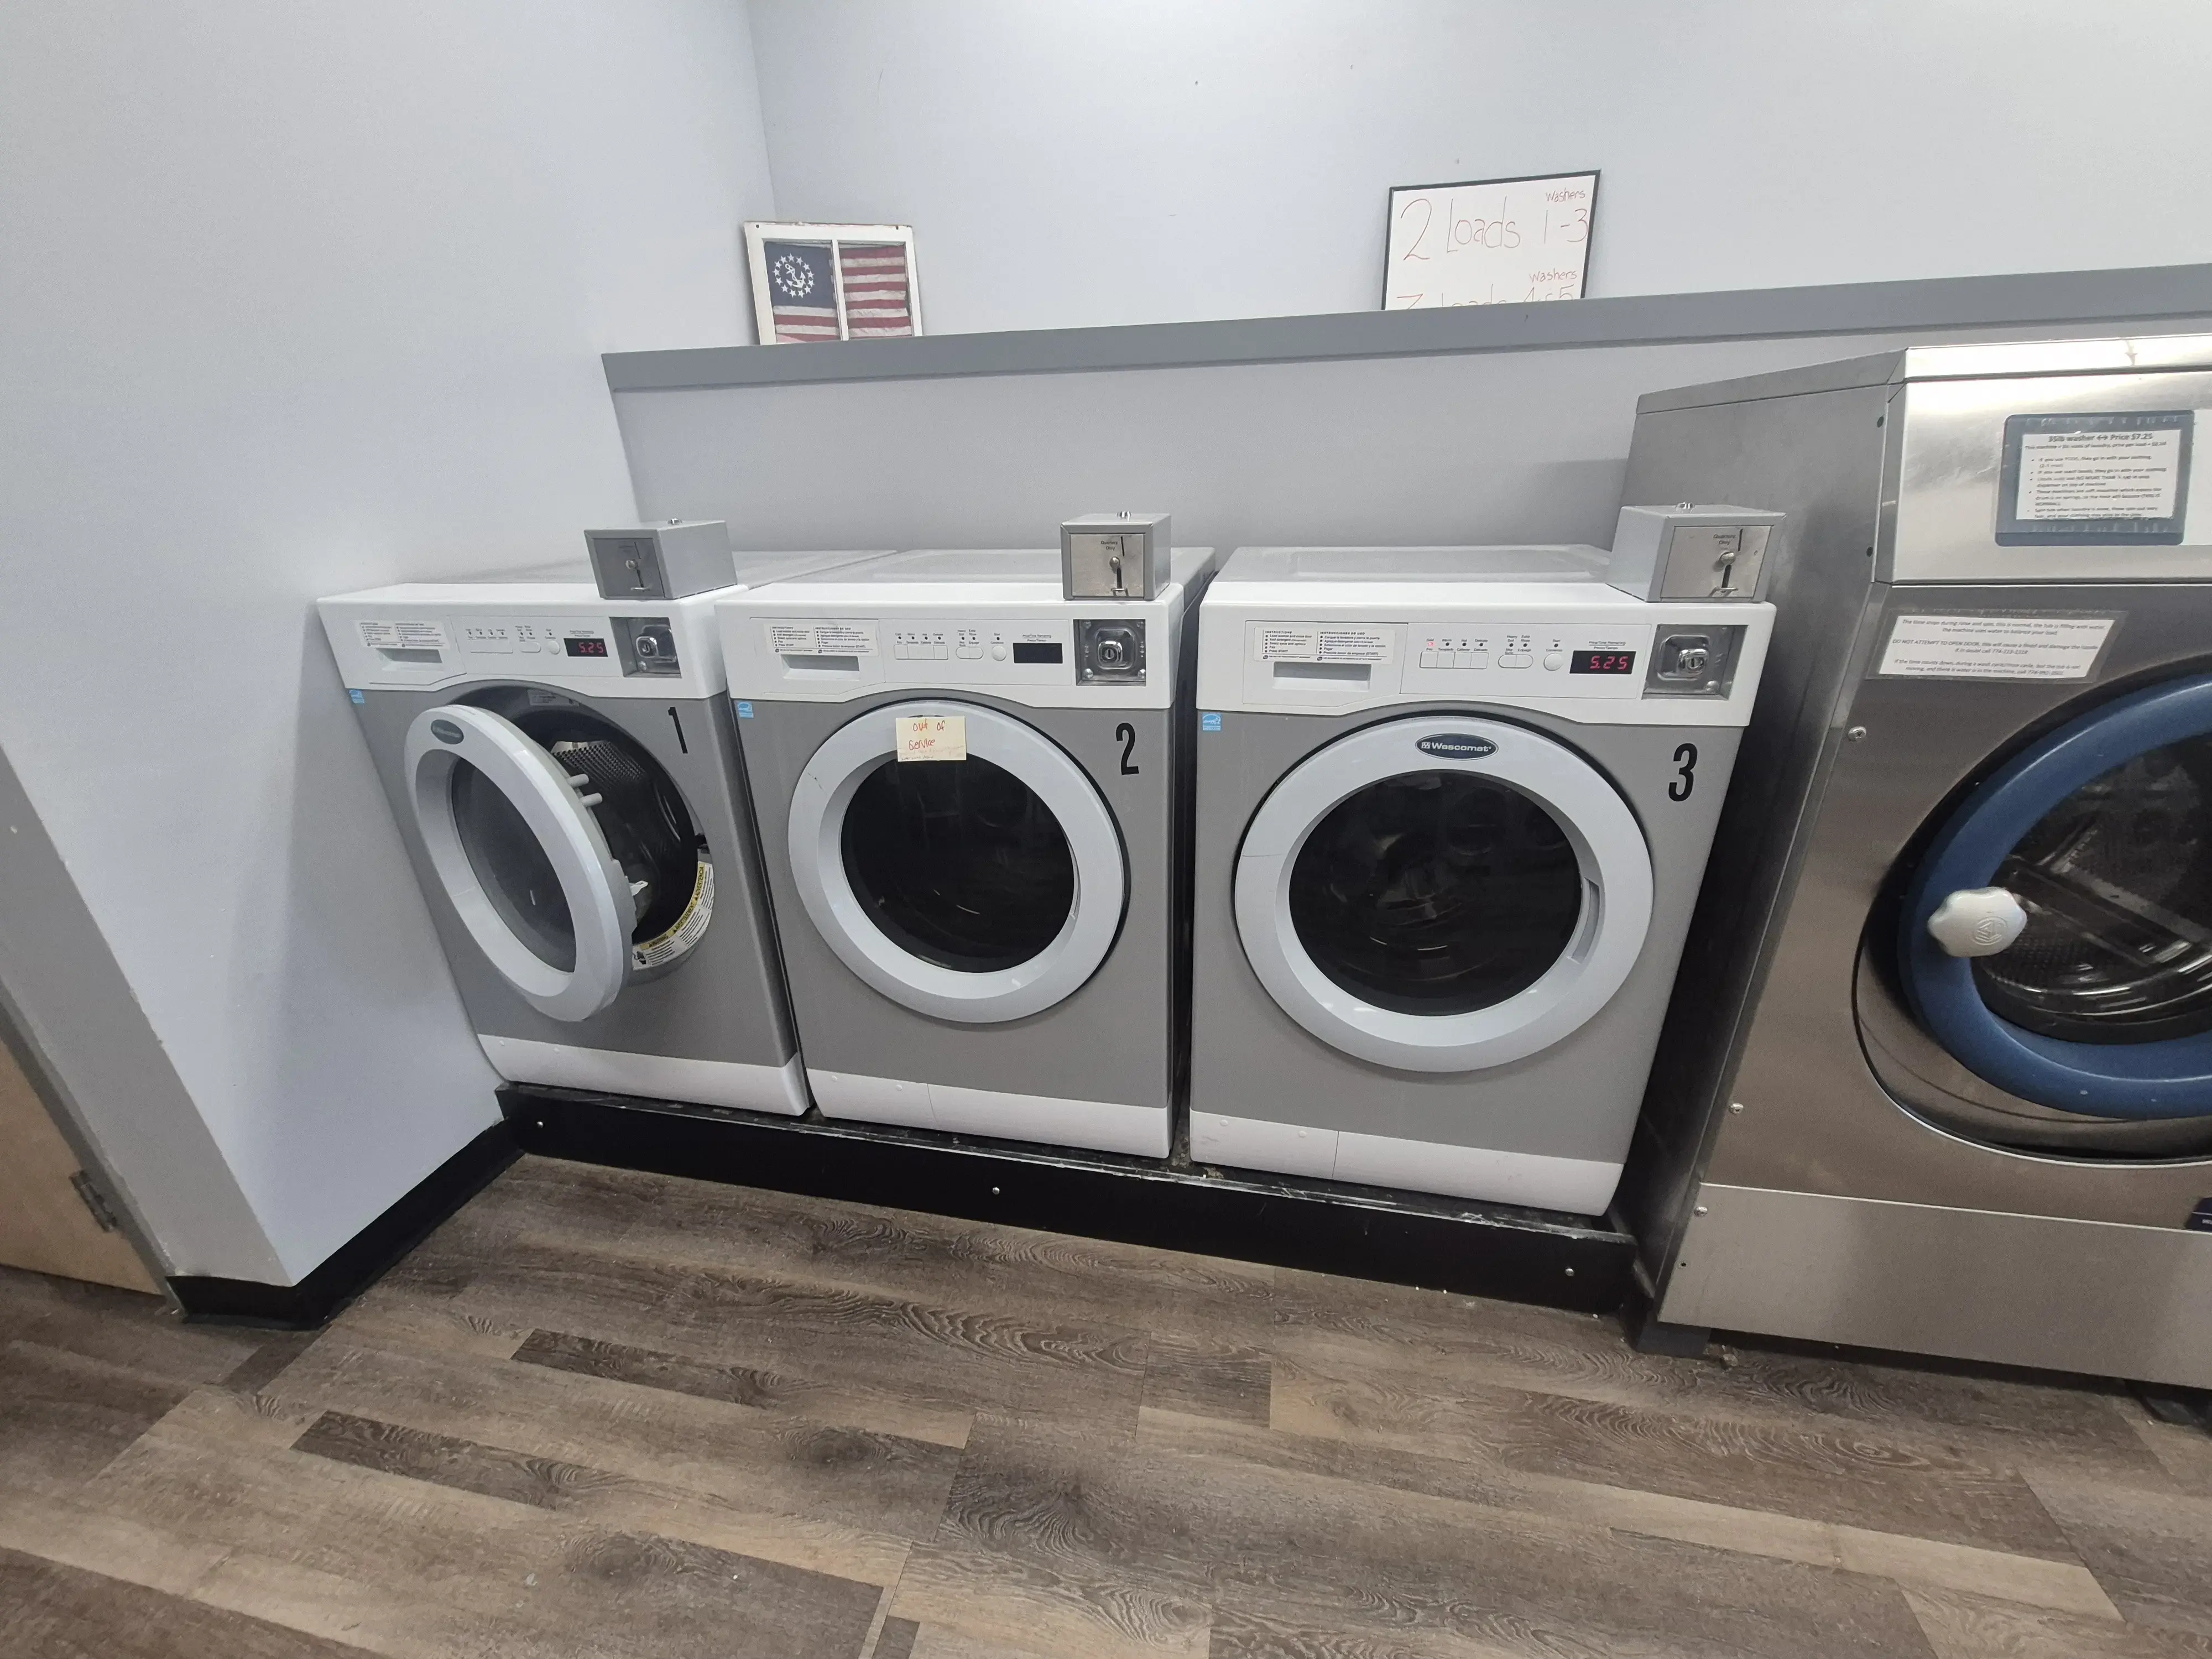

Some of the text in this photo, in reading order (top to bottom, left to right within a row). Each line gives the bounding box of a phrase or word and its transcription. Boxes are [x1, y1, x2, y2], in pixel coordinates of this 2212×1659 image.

[1401, 198, 1432, 261] 2
[668, 707, 688, 754] 1
[1116, 723, 1139, 775] 2
[1431, 742, 1490, 752] Wascomat
[1668, 743, 1697, 802] 3
